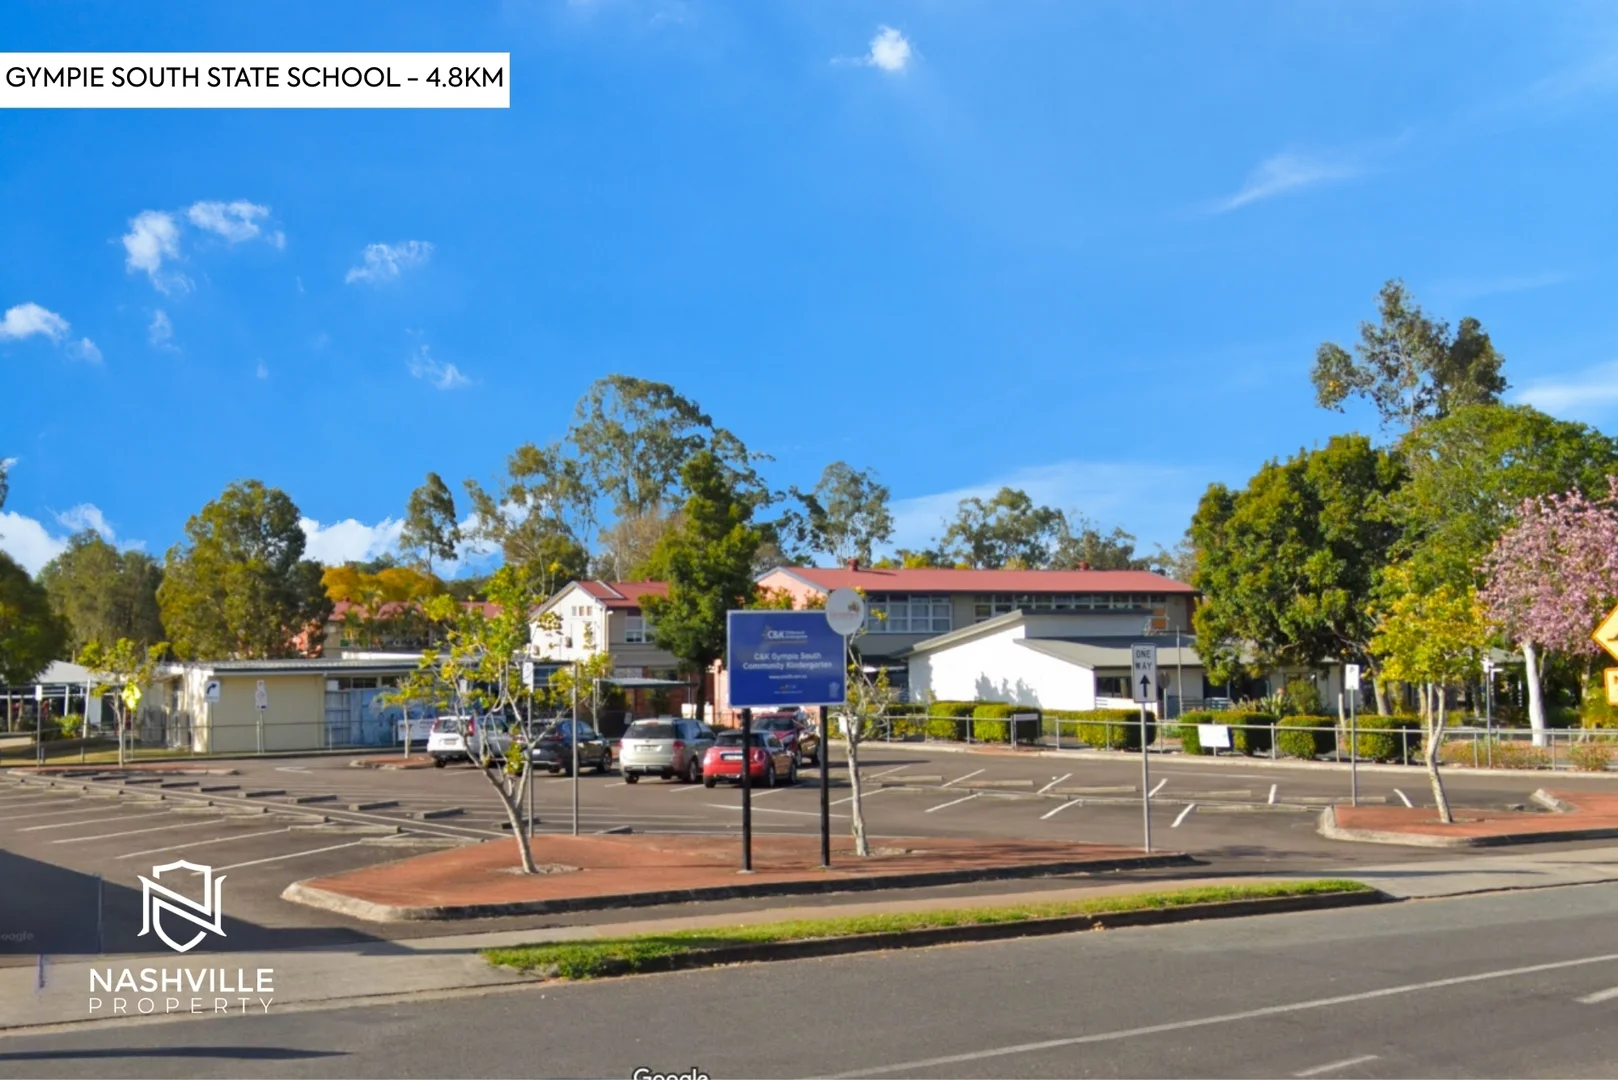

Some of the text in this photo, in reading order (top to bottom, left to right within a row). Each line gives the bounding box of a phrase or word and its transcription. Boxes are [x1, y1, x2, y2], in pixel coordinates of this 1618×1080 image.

[771, 652, 799, 662] Gympie
[800, 652, 822, 660] South
[1135, 650, 1151, 658] ONE
[742, 661, 833, 671] Community Kindergarten
[1135, 662, 1152, 670] WAY
